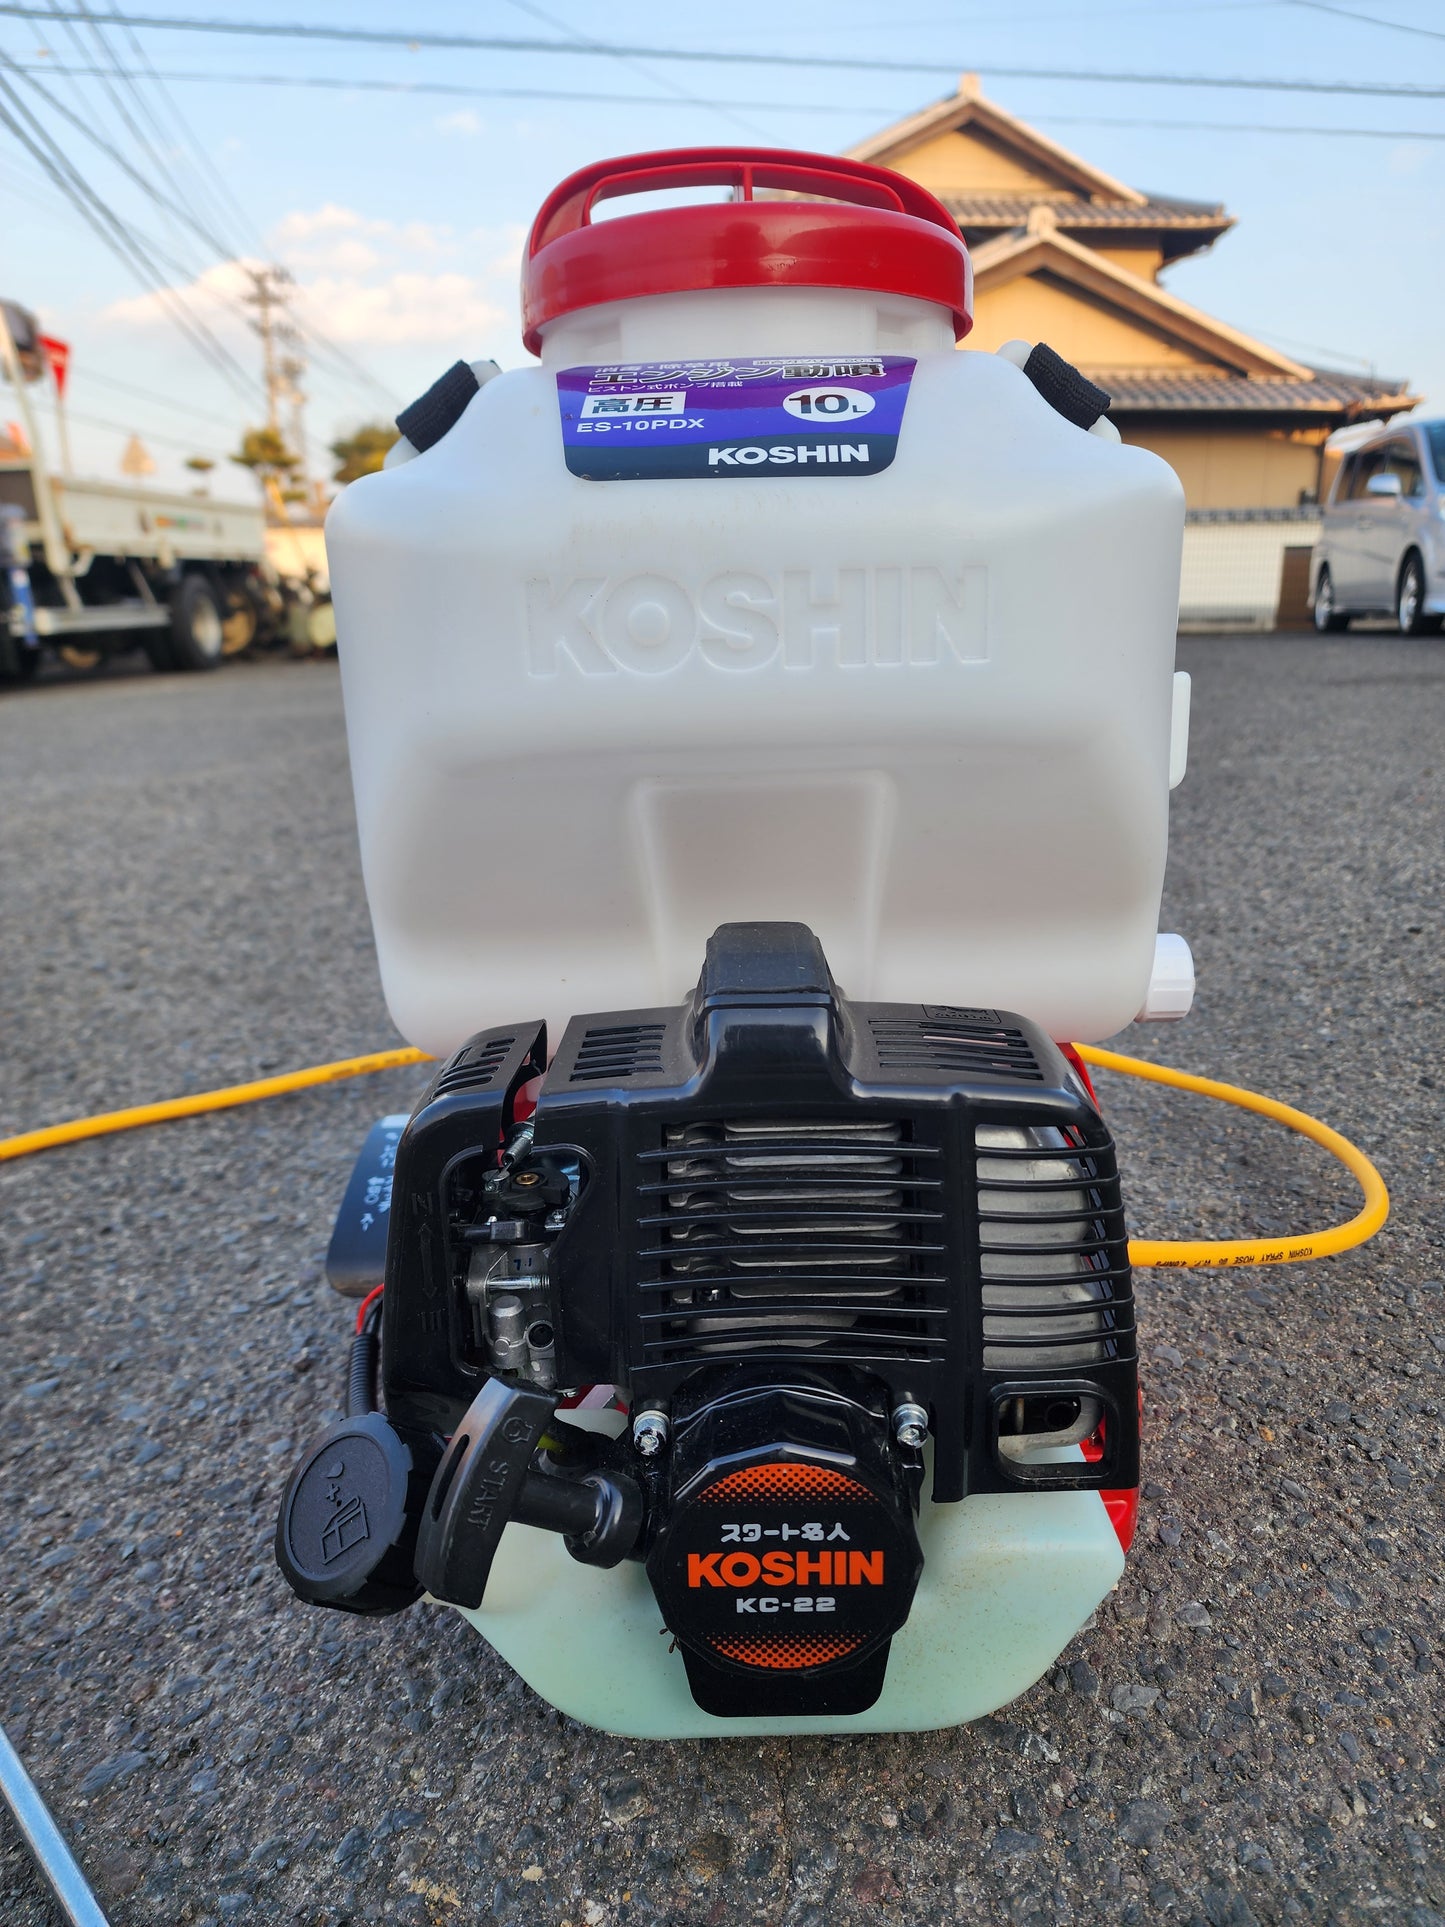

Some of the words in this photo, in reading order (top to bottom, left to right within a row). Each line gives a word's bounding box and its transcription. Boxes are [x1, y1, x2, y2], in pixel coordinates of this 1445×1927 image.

[589, 363, 886, 386] エンジン動噴
[587, 381, 743, 393] ピストン式ポンプ搭載
[592, 394, 675, 414] 高圧
[577, 418, 705, 433] ES-10PDX
[708, 444, 870, 466] KOSHIN
[523, 562, 990, 679] KOSHIN
[1232, 1255, 1255, 1264] HOSE
[1261, 1251, 1284, 1262] SPRAY
[1287, 1246, 1313, 1259] KOSHIN
[468, 1459, 508, 1531] START
[720, 1522, 851, 1543] スタート名人
[687, 1550, 885, 1588] KOSHIN
[736, 1596, 837, 1613] KC-22
